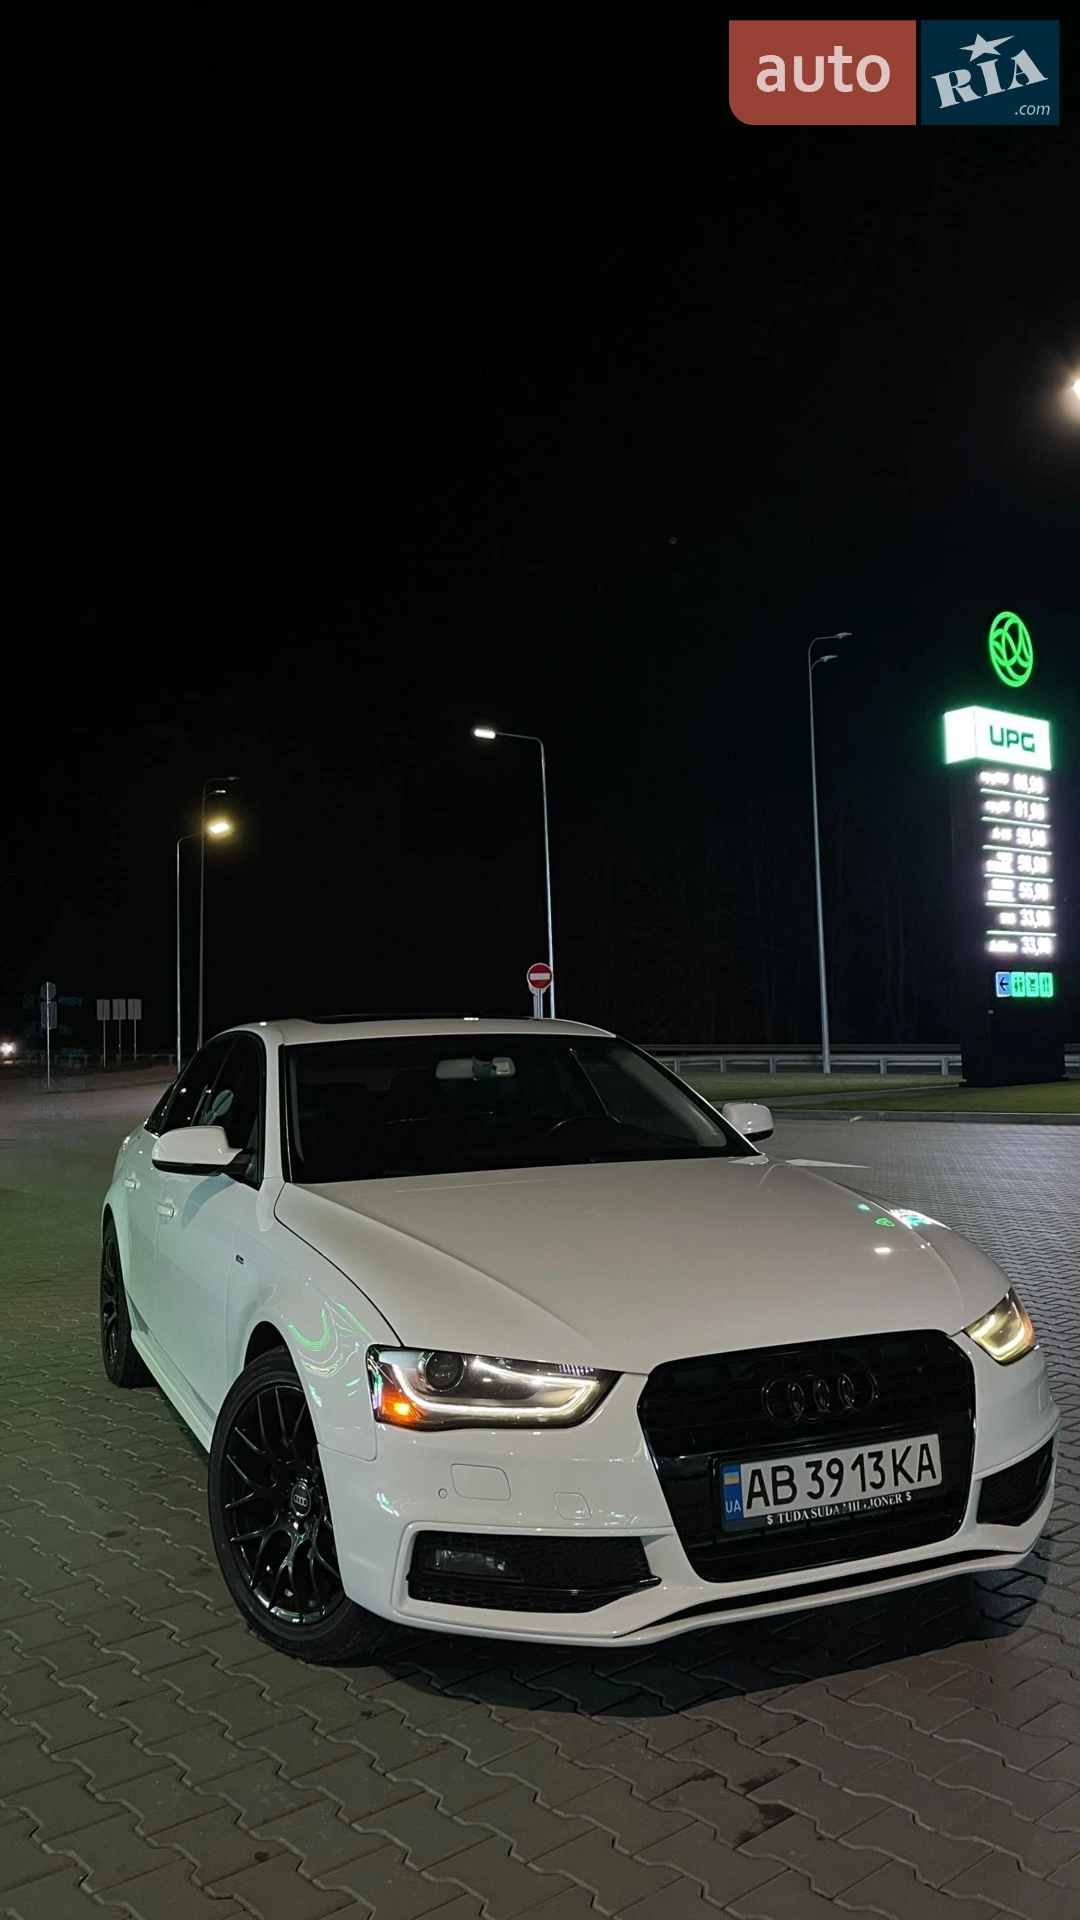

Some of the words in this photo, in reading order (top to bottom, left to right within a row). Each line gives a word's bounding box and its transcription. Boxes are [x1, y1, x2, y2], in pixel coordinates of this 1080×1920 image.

[989, 724, 1036, 753] UPG
[725, 1499, 742, 1514] UA
[777, 1510, 809, 1524] TUDA
[811, 1505, 841, 1519] SUDA
